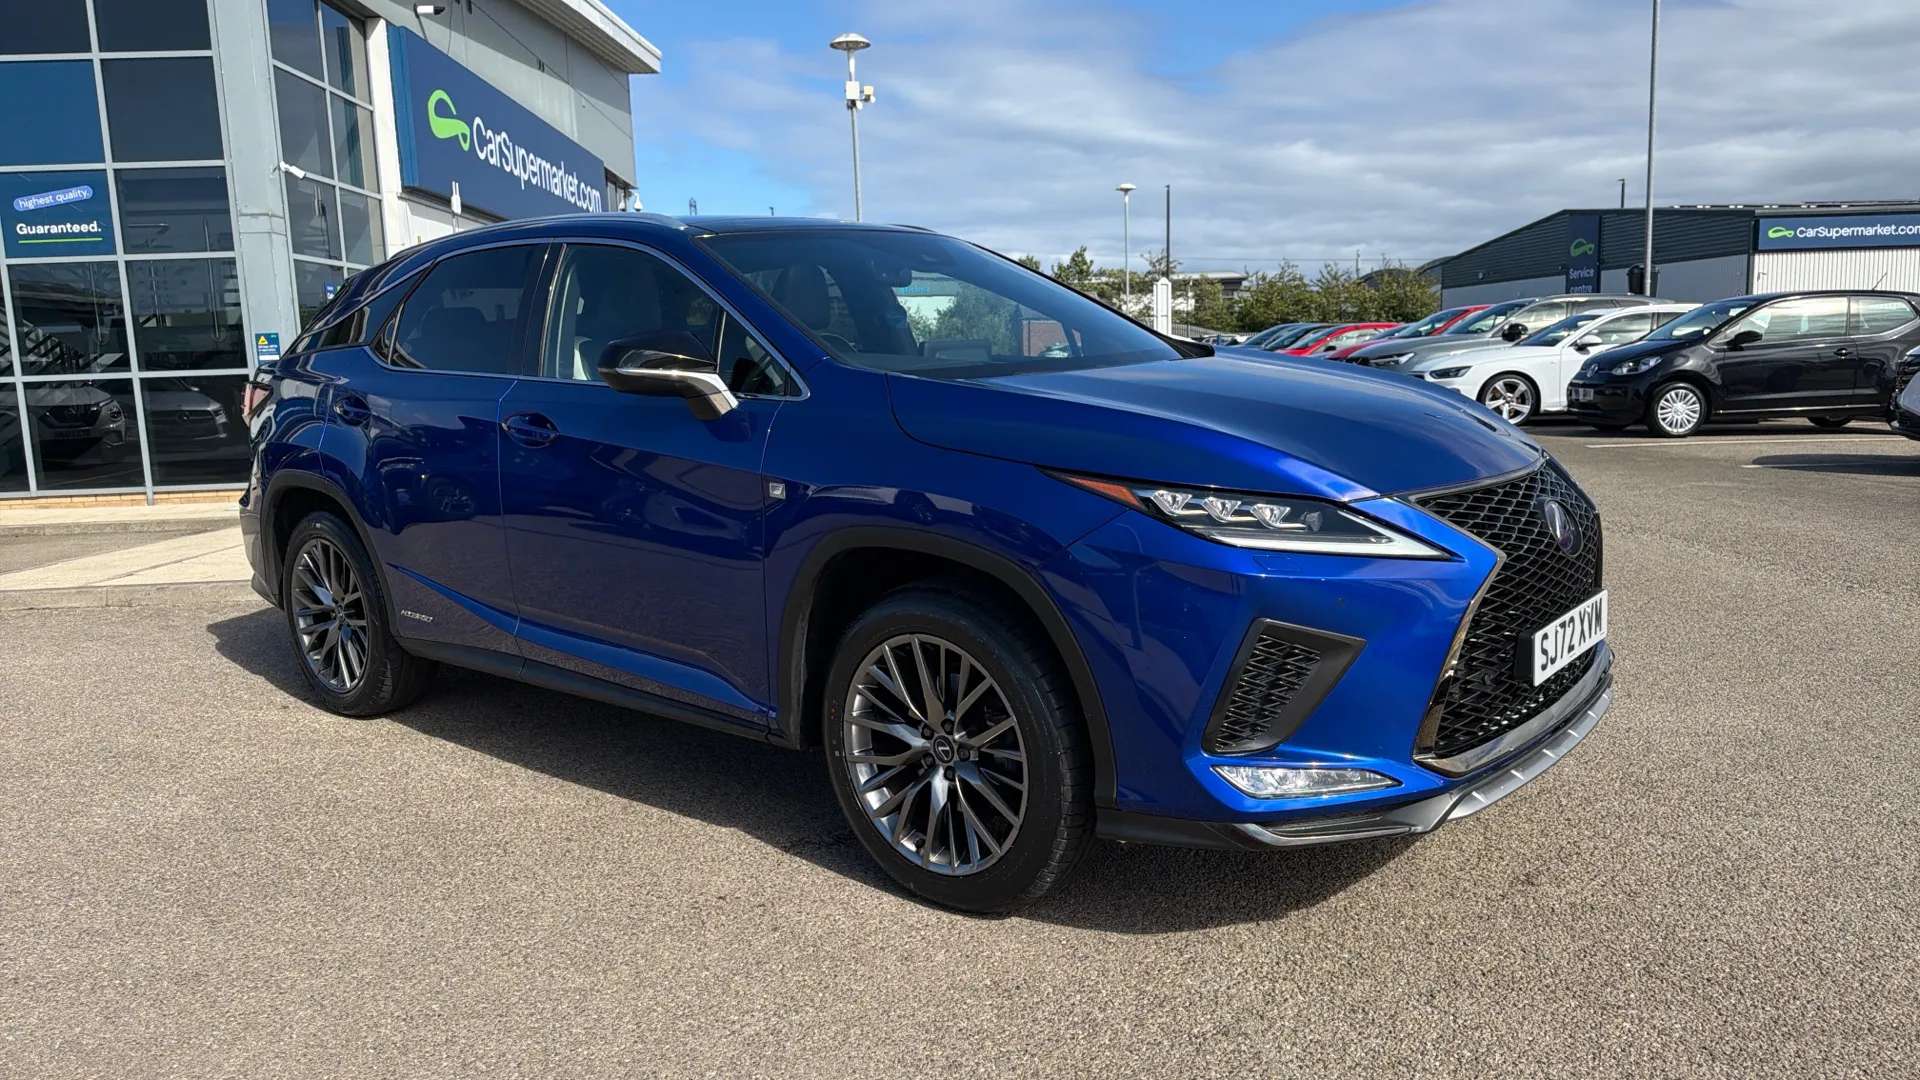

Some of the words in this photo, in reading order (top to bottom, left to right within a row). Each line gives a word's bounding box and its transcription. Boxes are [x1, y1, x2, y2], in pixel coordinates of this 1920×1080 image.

[472, 116, 602, 213] CarSupermarket.com
[19, 194, 54, 210] highest
[56, 188, 90, 203] quality.
[16, 220, 102, 235] Guaranteed.
[1540, 615, 1576, 672] SJ72
[1578, 597, 1603, 647] XVM
